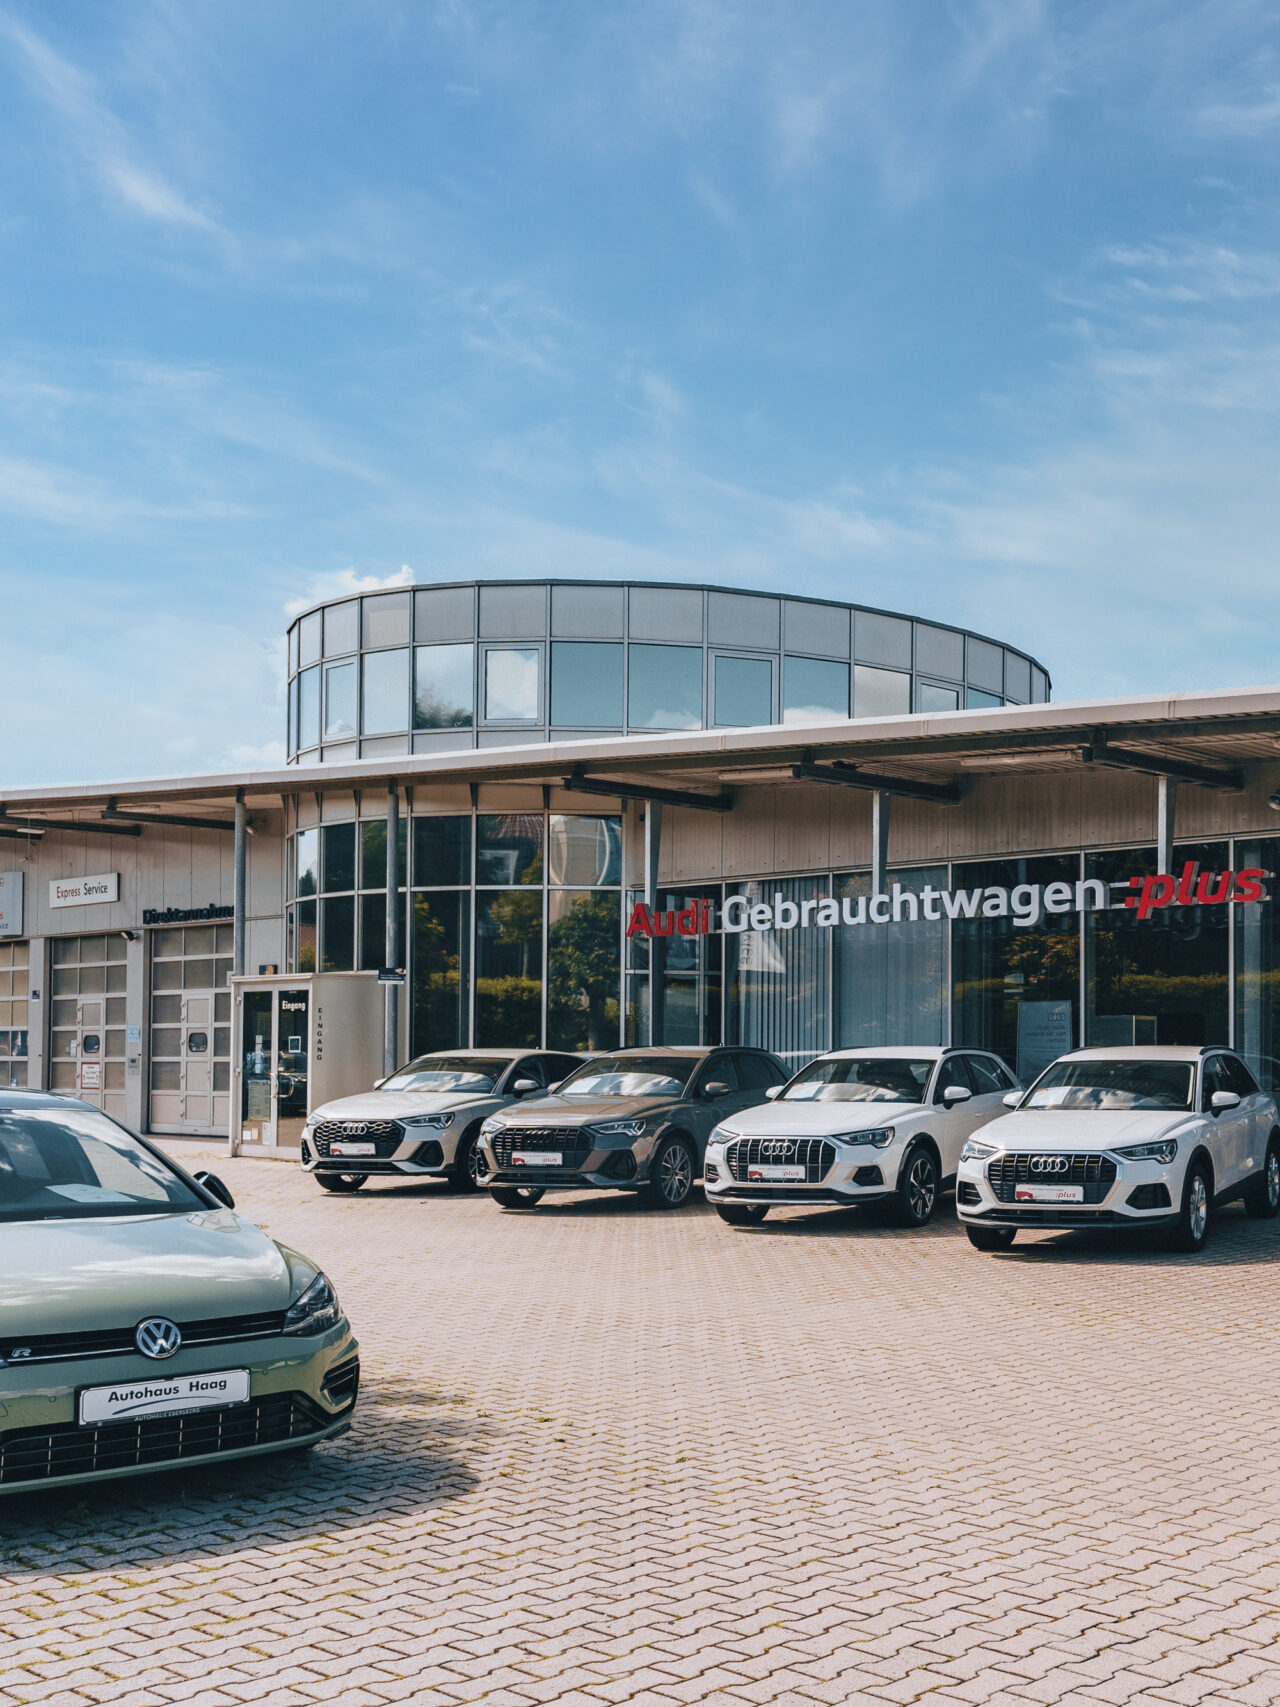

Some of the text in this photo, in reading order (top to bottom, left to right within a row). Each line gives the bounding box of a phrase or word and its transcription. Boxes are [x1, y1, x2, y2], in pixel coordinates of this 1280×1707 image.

[56, 882, 108, 900] Express Service
[625, 898, 709, 938] Audi
[721, 877, 1106, 933] Gebrauchtwagen
[282, 1000, 306, 1012] Eingang
[108, 1379, 227, 1403] Autohaus Haag
